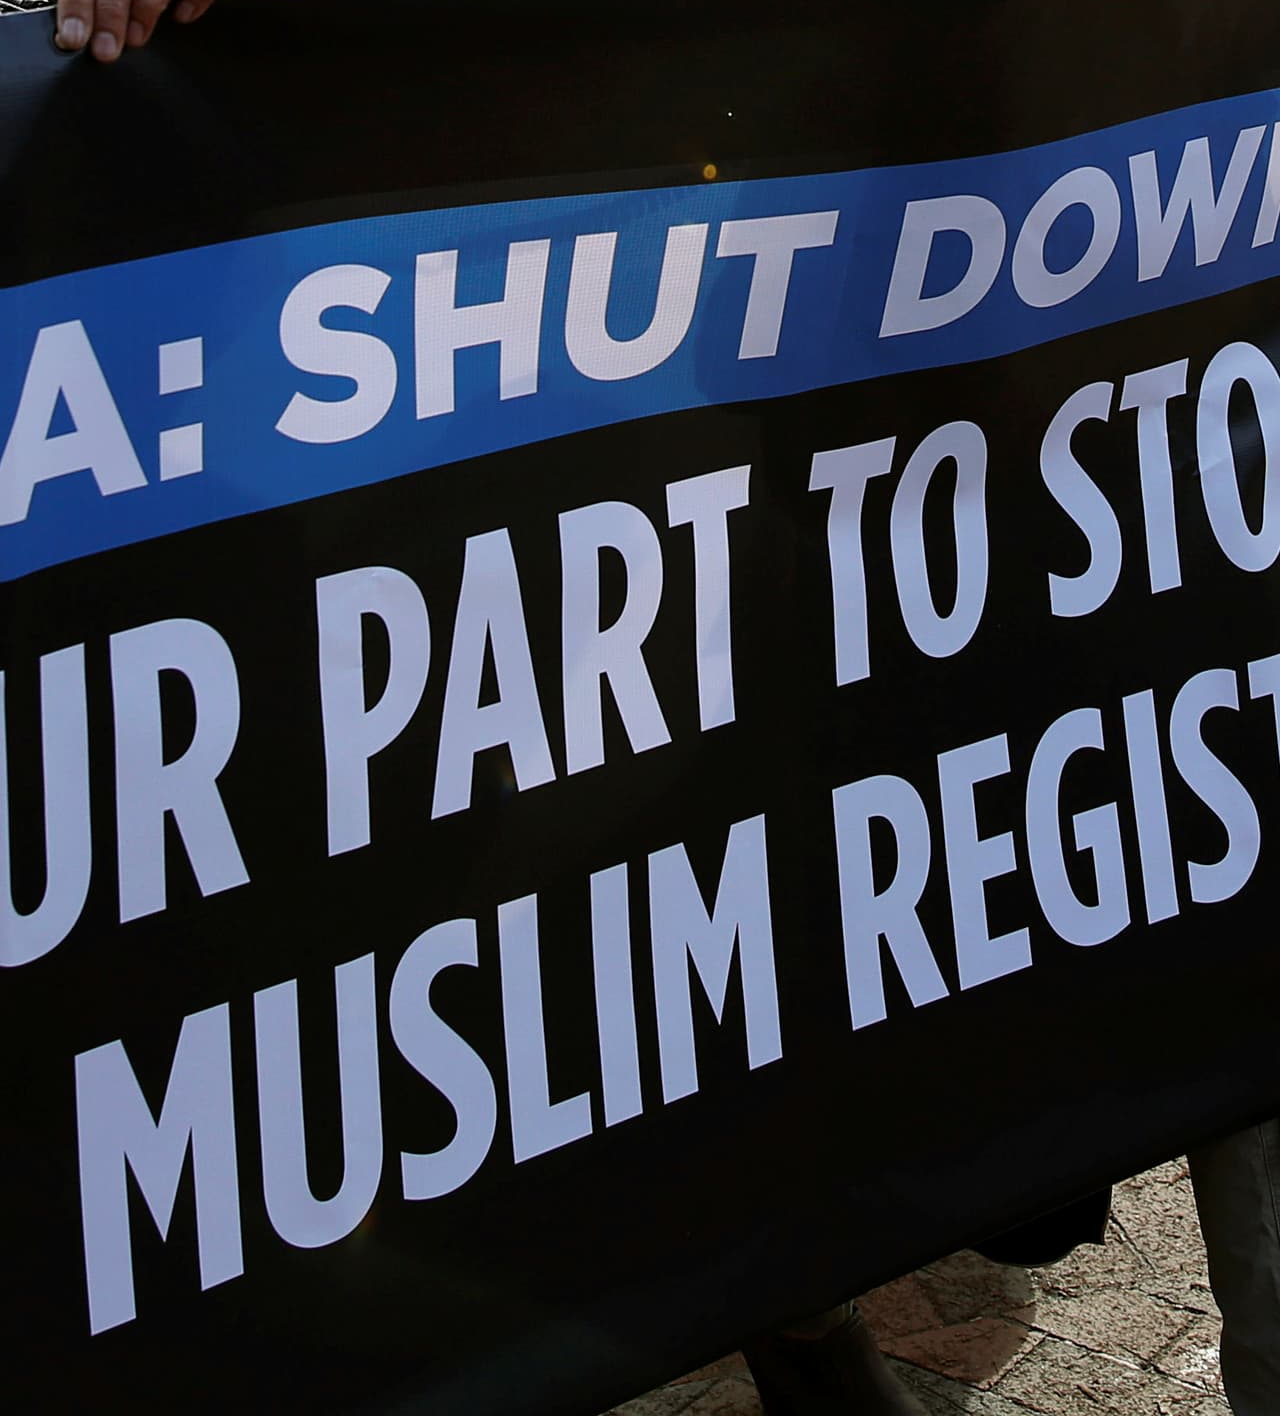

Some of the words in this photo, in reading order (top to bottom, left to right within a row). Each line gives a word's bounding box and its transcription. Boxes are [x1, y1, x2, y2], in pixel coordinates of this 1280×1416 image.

[274, 210, 840, 444] SHUT
[315, 464, 752, 857] PART
[807, 420, 989, 687] TO
[74, 813, 783, 1336] MUSLIM
